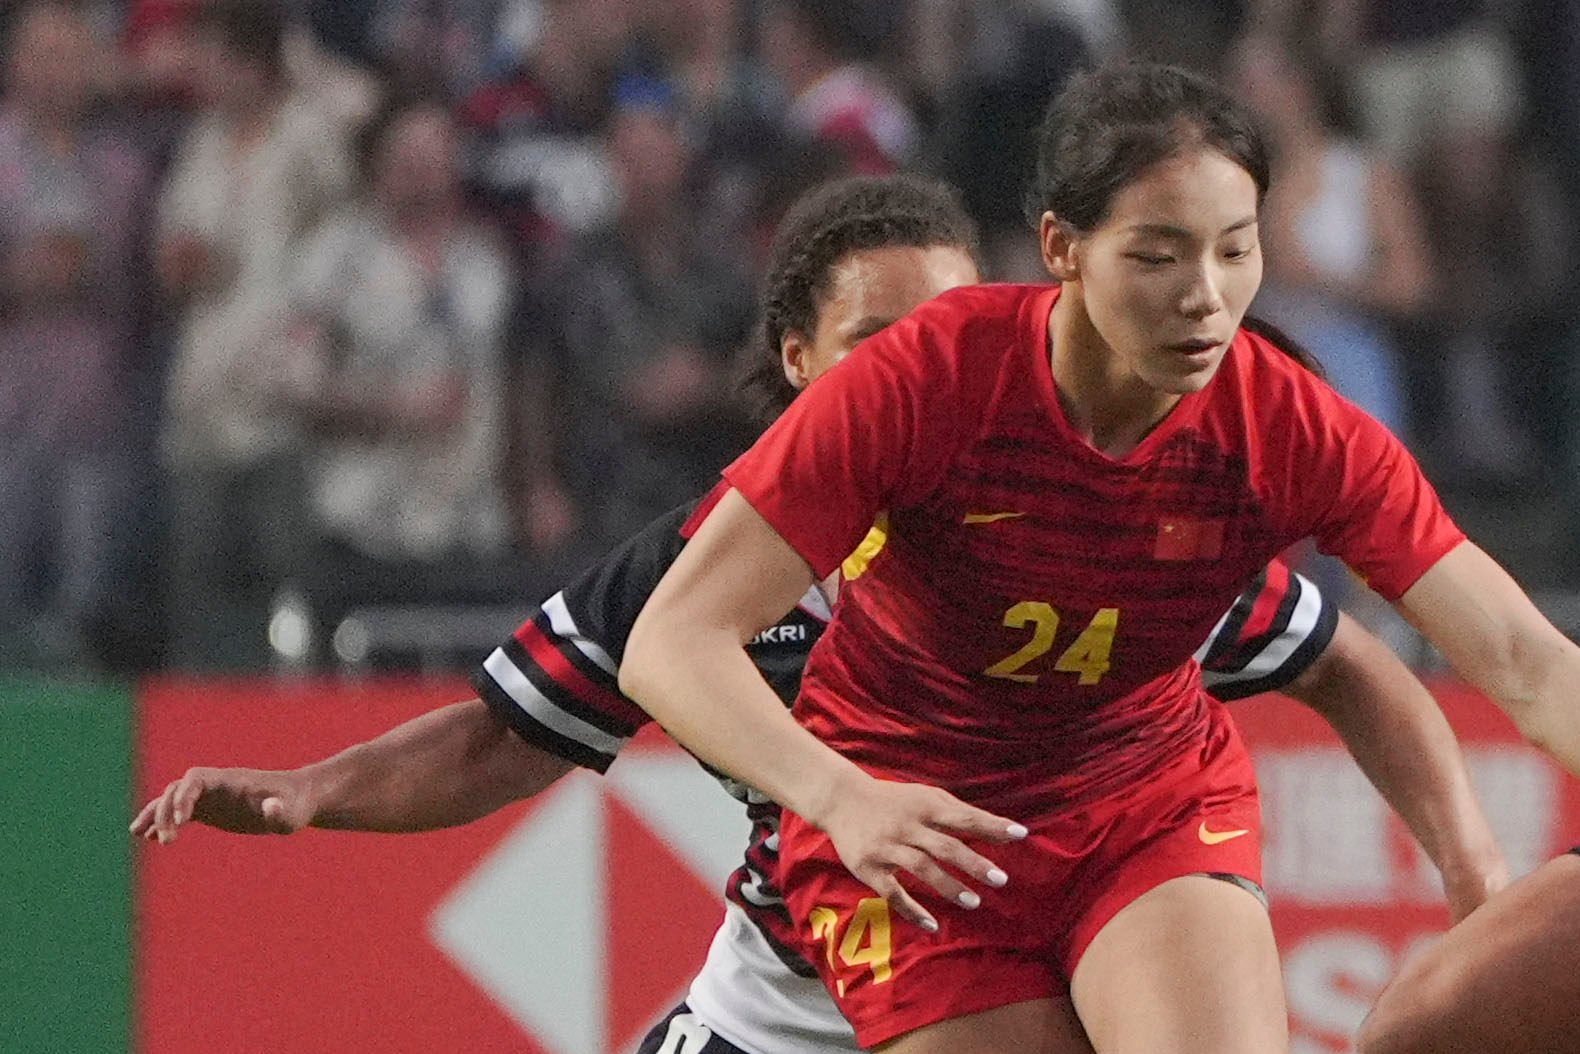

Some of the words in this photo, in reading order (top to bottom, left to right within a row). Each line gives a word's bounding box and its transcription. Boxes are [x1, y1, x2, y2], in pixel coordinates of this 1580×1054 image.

[752, 624, 805, 645] KRI
[983, 601, 1119, 685] 24
[809, 898, 893, 998] 24
